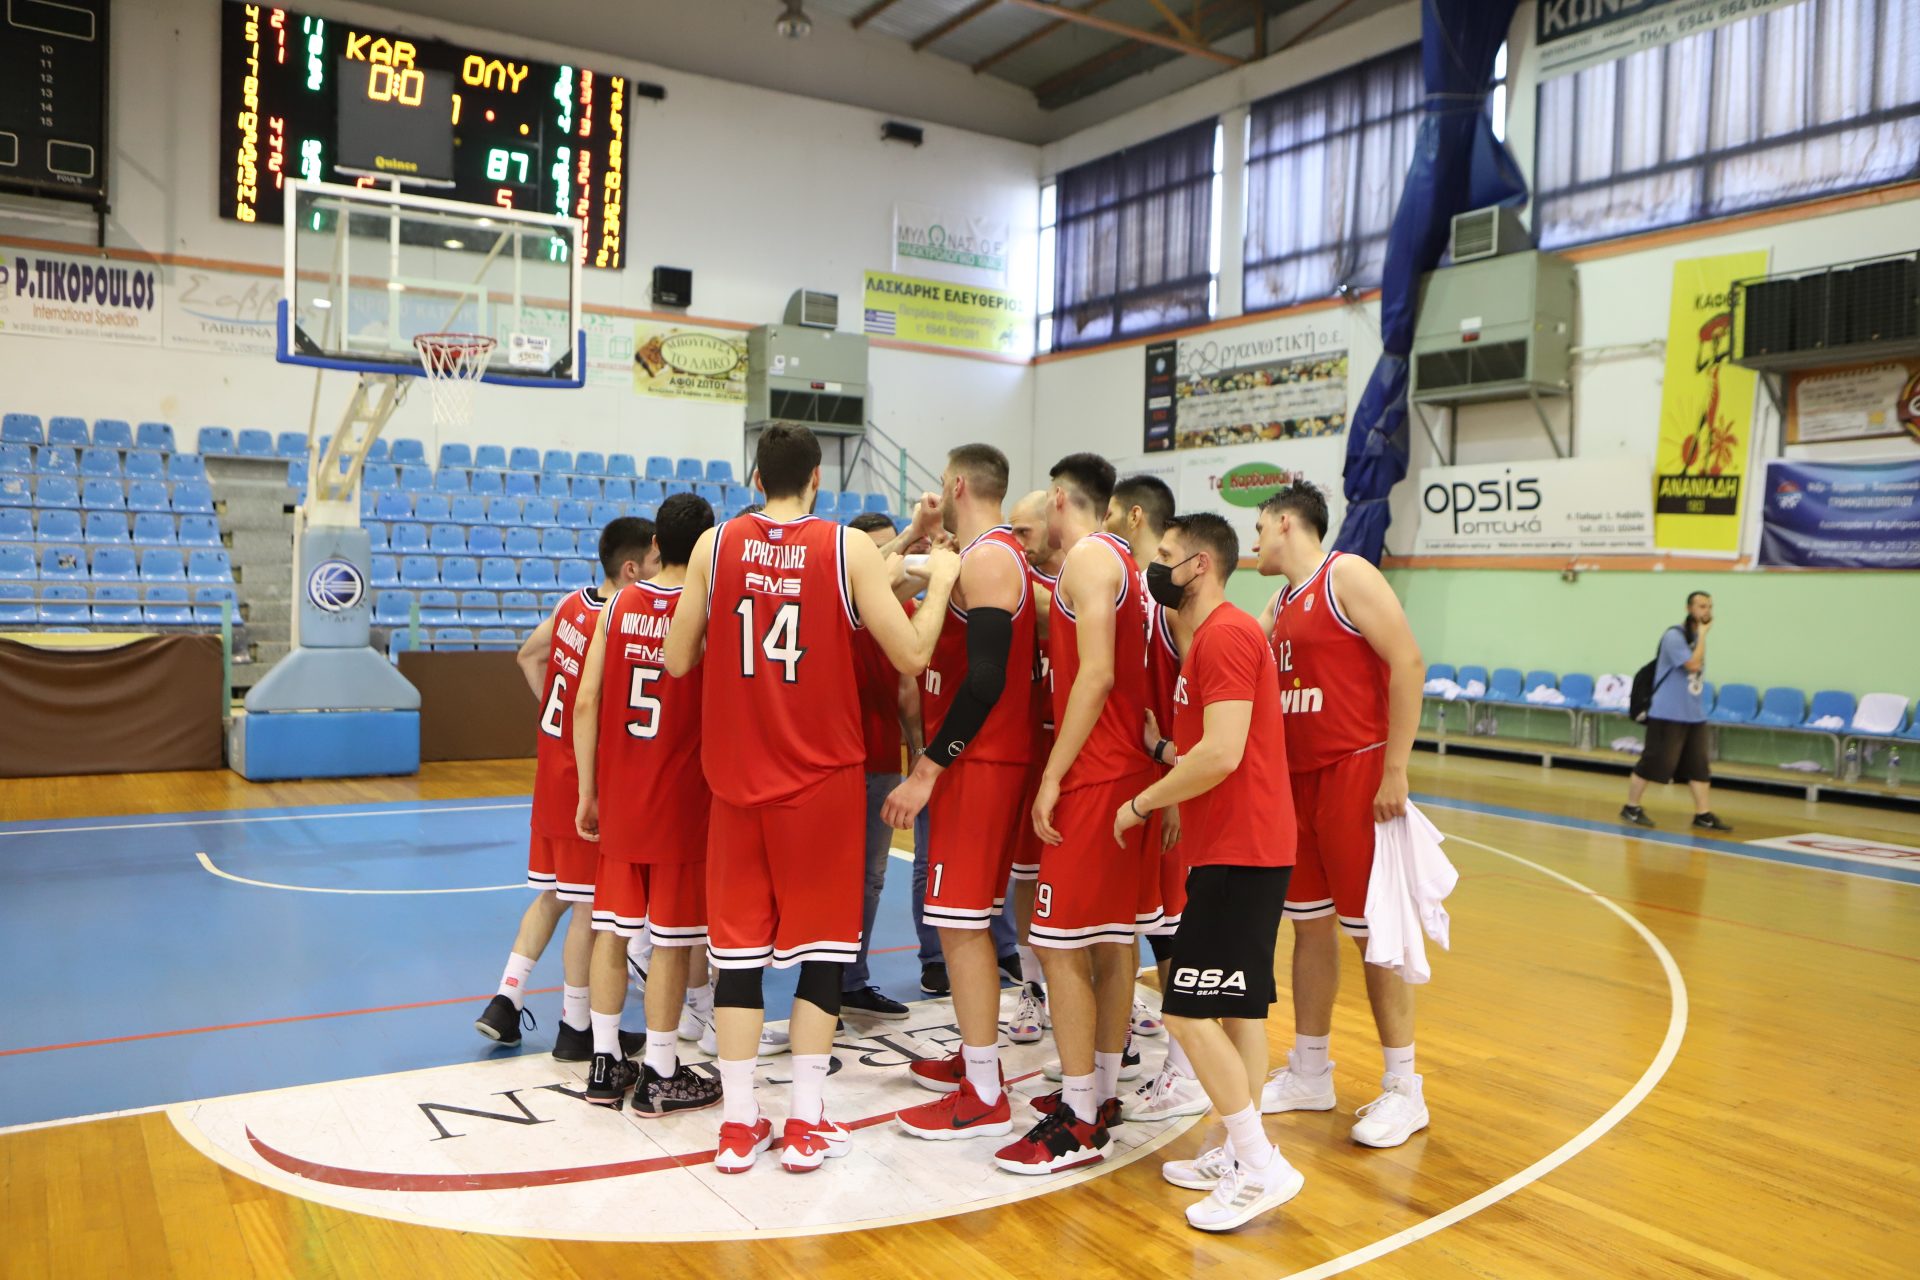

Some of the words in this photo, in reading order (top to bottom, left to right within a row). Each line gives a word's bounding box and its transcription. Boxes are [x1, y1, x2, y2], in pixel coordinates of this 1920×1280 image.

[486, 148, 529, 184] 87
[15, 256, 155, 313] P.TIKOPOULOS
[865, 276, 941, 301] ΛΑΣΚΑΡΗΣ
[32, 303, 94, 324] International
[1424, 468, 1543, 534] opsis
[741, 538, 808, 570] ΧΡΗΣΤΙΔΗΣ
[745, 571, 802, 597] FMS
[732, 597, 808, 684] 14
[1279, 639, 1293, 673] 12
[540, 671, 568, 739] 6
[626, 664, 662, 740] 5
[1173, 967, 1247, 990] GSA
